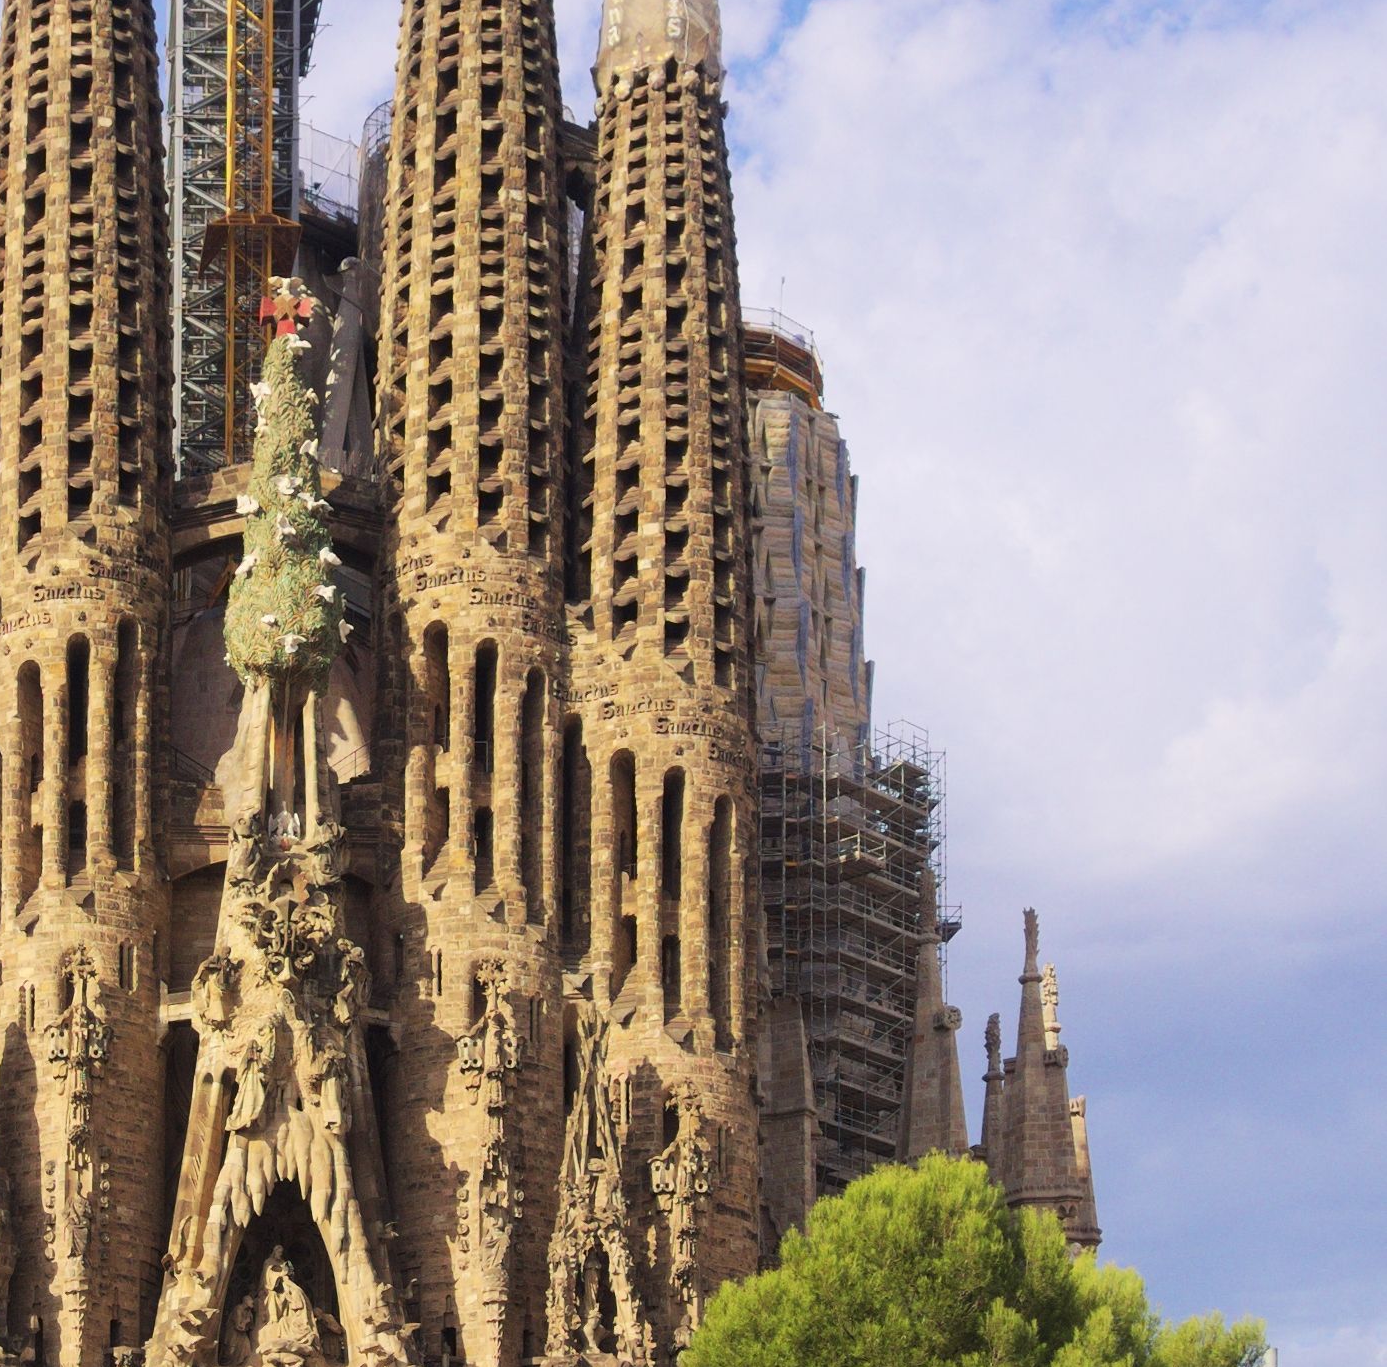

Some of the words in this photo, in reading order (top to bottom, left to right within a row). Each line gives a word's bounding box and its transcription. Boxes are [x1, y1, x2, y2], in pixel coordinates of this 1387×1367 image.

[415, 567, 487, 592] Sanctus
[33, 582, 106, 603] Sanctus
[602, 696, 676, 721] Sanctus
